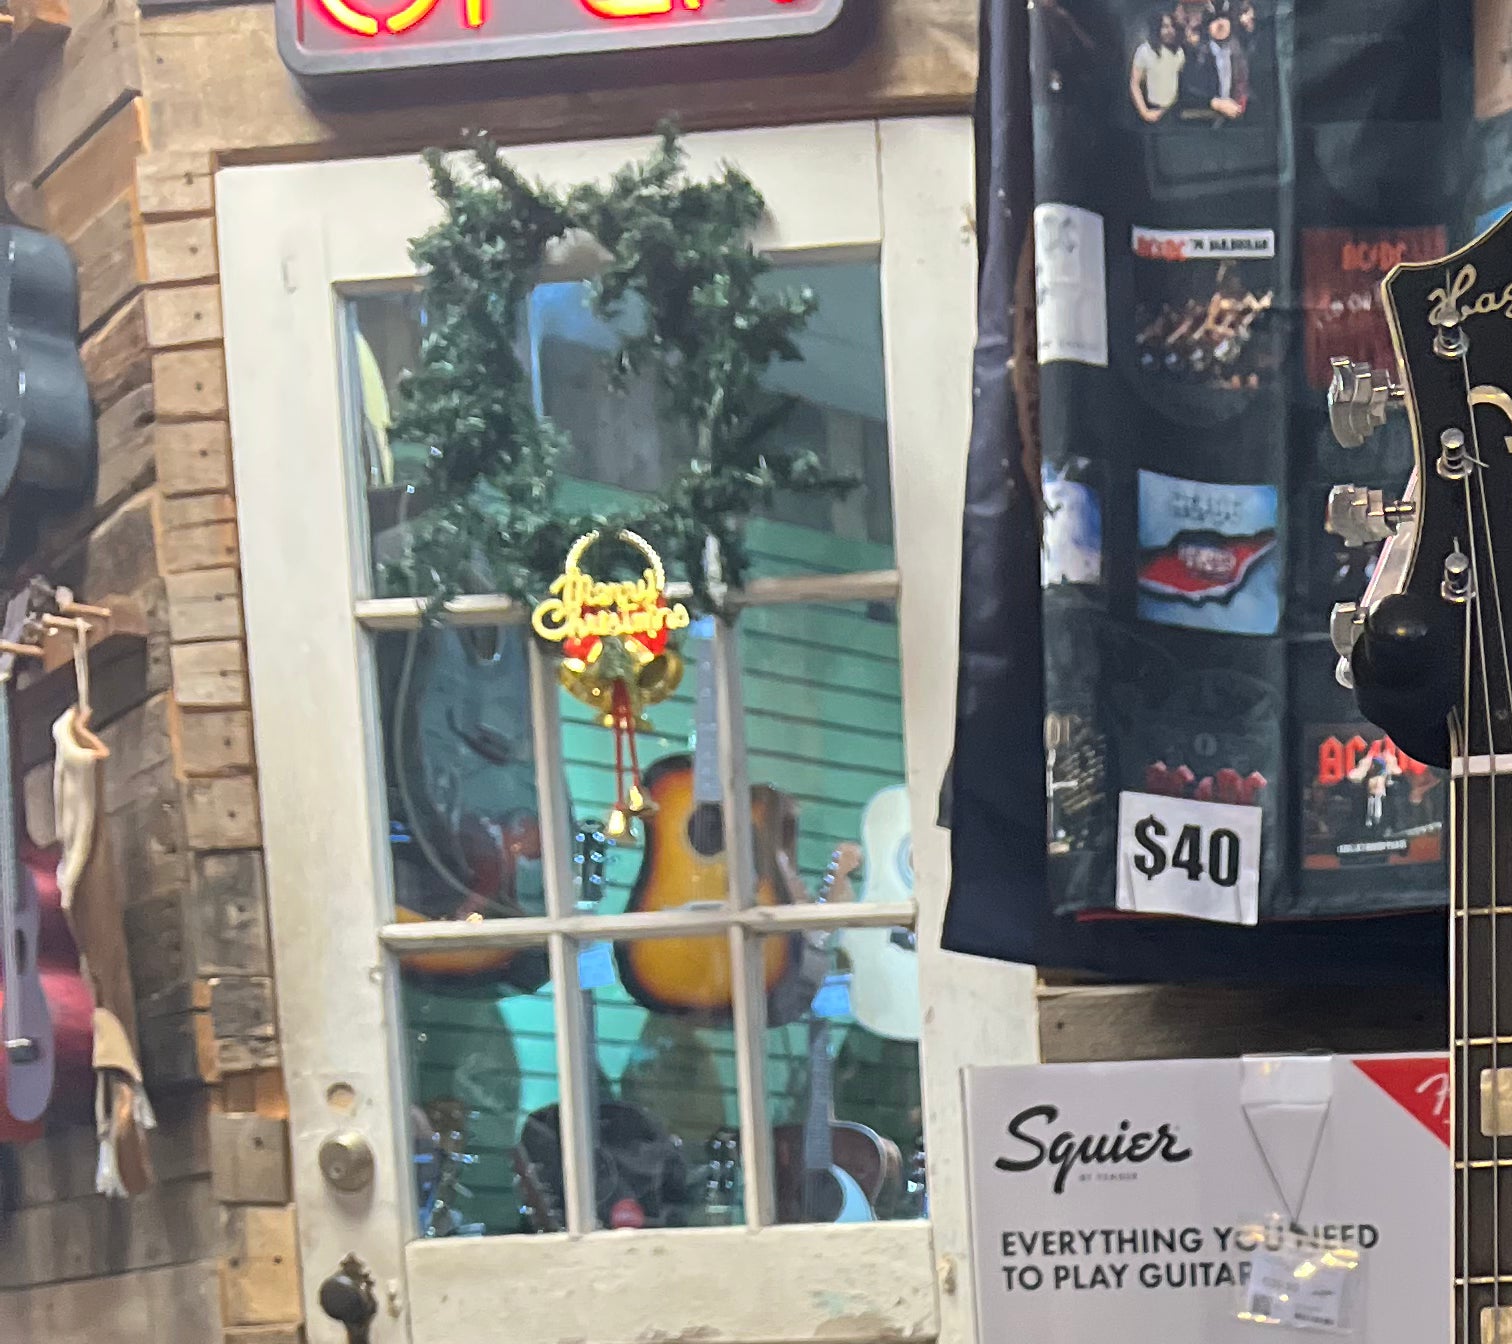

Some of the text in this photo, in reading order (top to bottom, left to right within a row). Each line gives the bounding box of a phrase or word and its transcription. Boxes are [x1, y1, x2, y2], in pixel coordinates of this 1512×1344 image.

[1134, 815, 1240, 888] $40
[995, 1104, 1192, 1195] Squier
[1002, 1227, 1201, 1256] EVERYTHING
[1214, 1225, 1284, 1251] YOU
[1002, 1265, 1042, 1291] TO
[1053, 1263, 1129, 1289] PLAY
